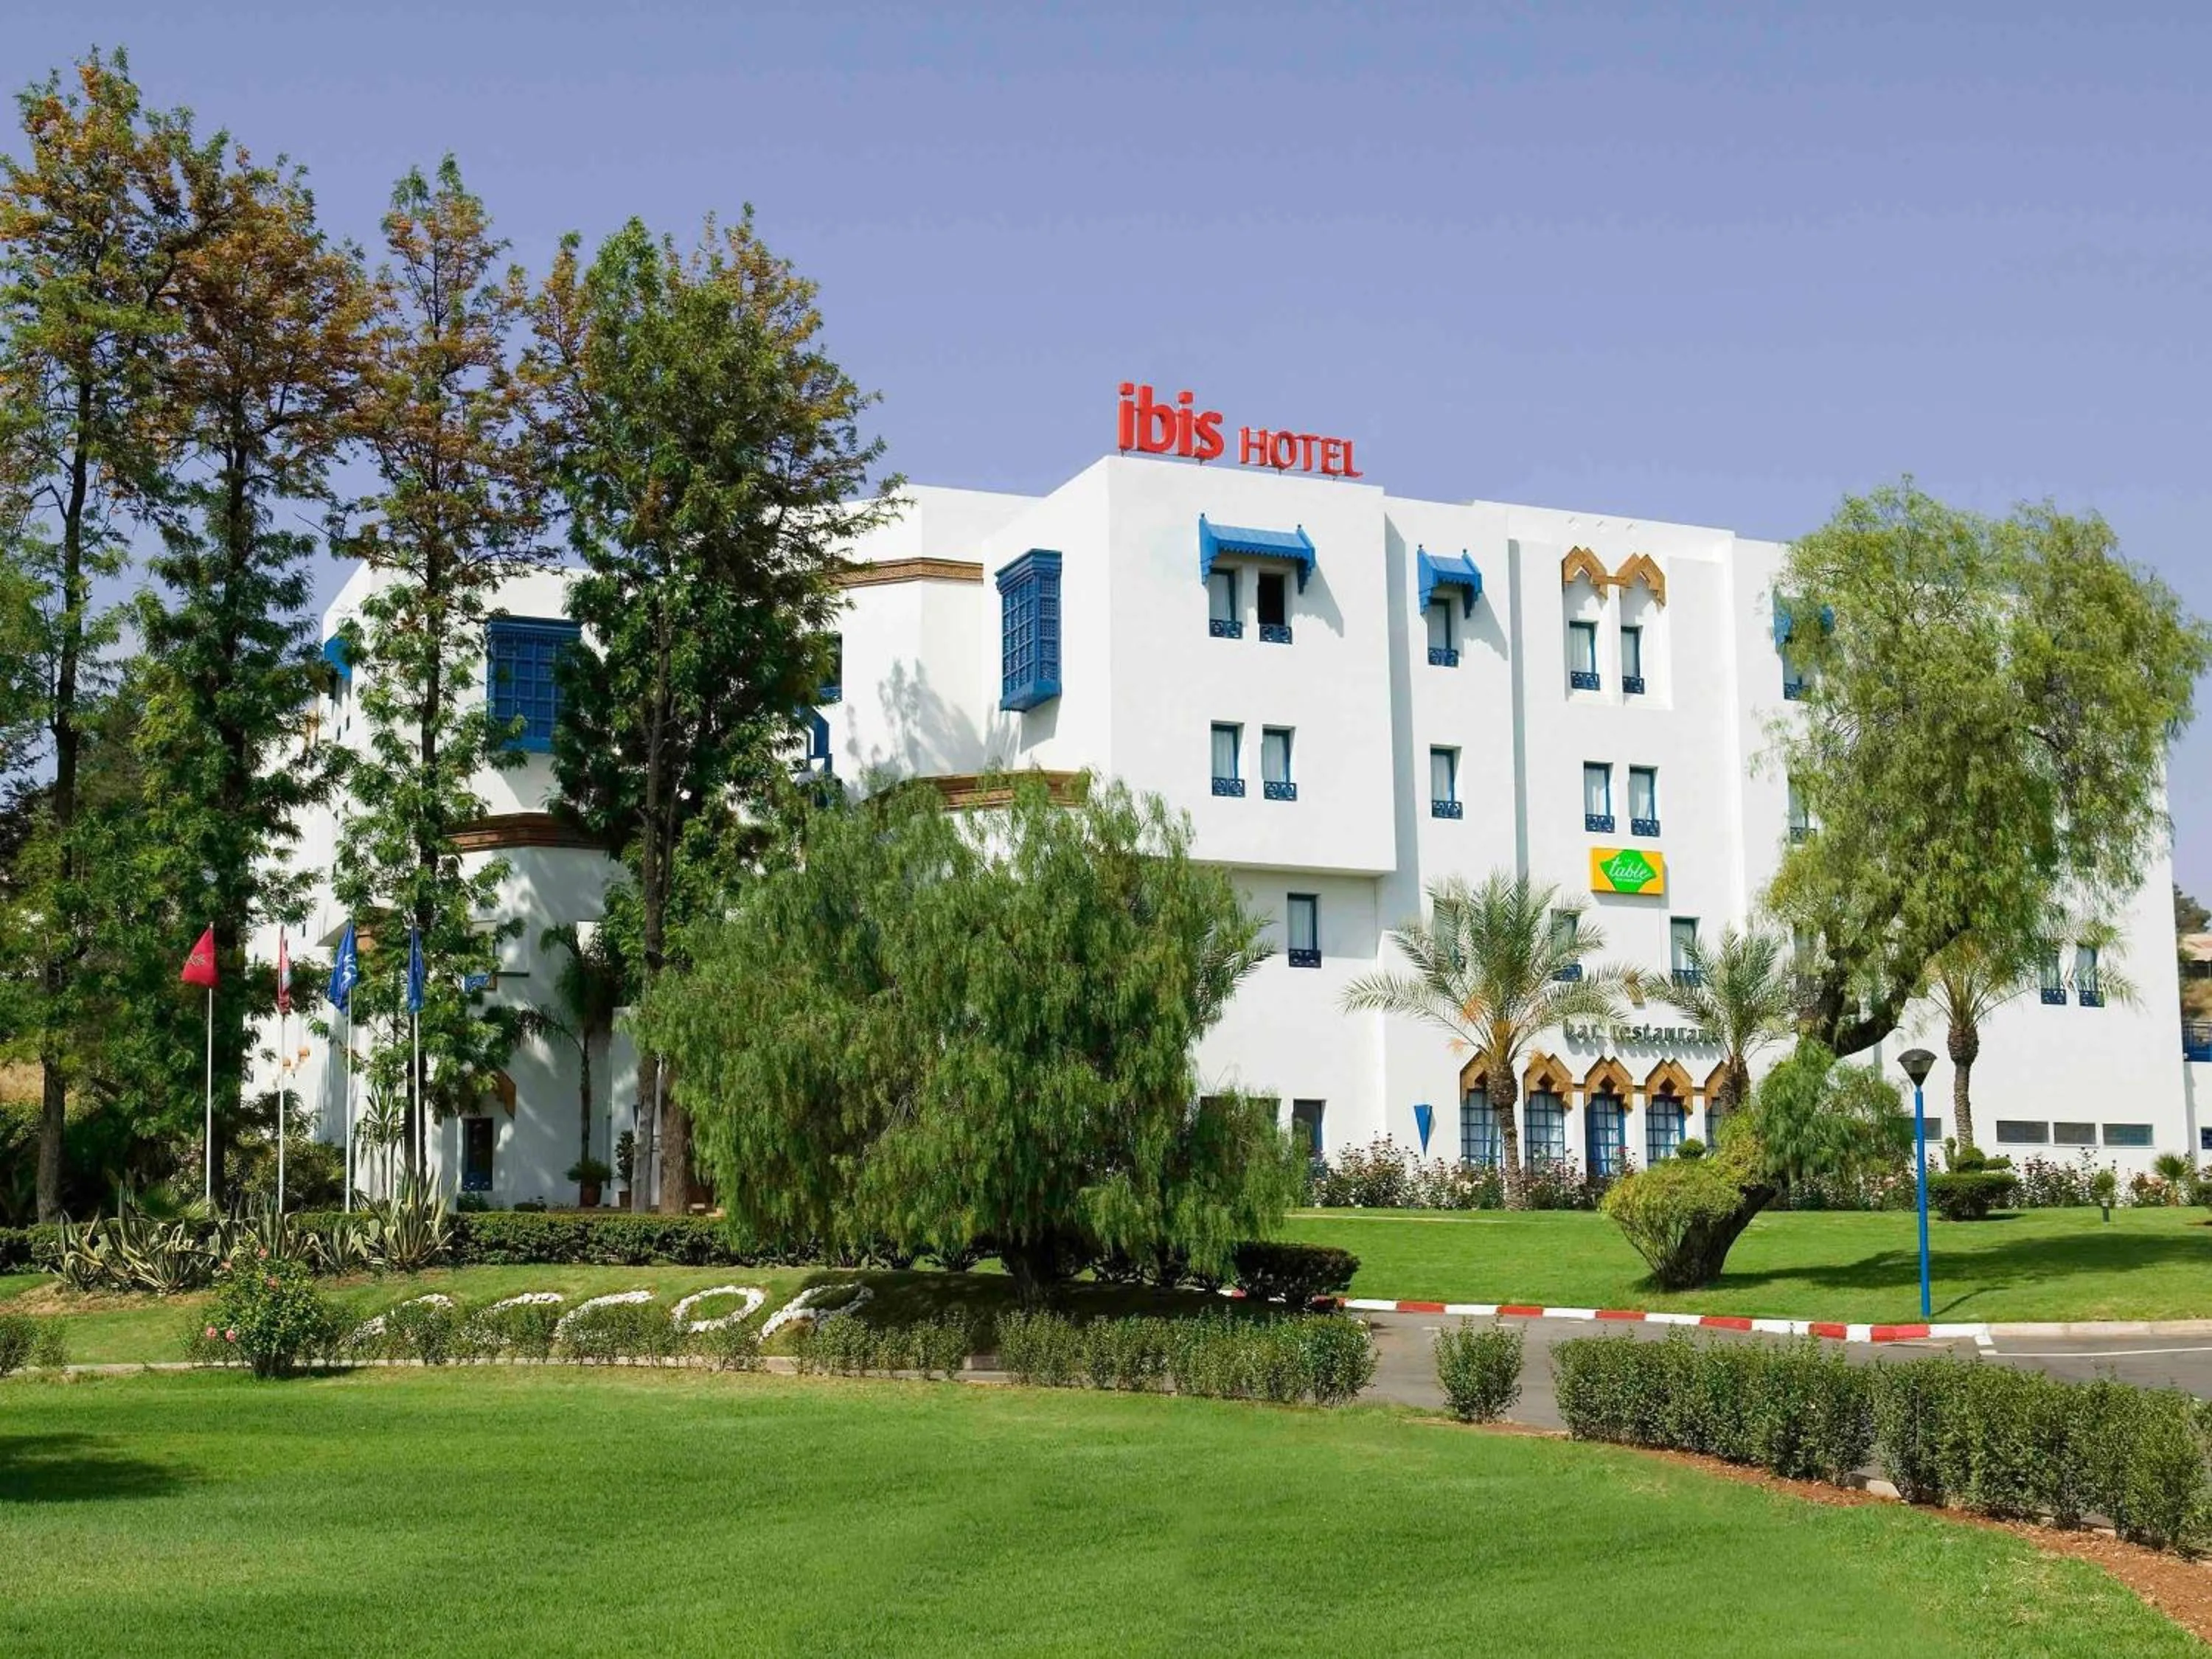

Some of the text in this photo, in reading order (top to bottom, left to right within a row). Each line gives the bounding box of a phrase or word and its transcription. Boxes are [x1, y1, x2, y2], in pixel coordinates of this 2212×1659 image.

[1118, 382, 1363, 478] ibis HOTEL
[1608, 856, 1653, 880] table
[1563, 1019, 1598, 1040] bar
